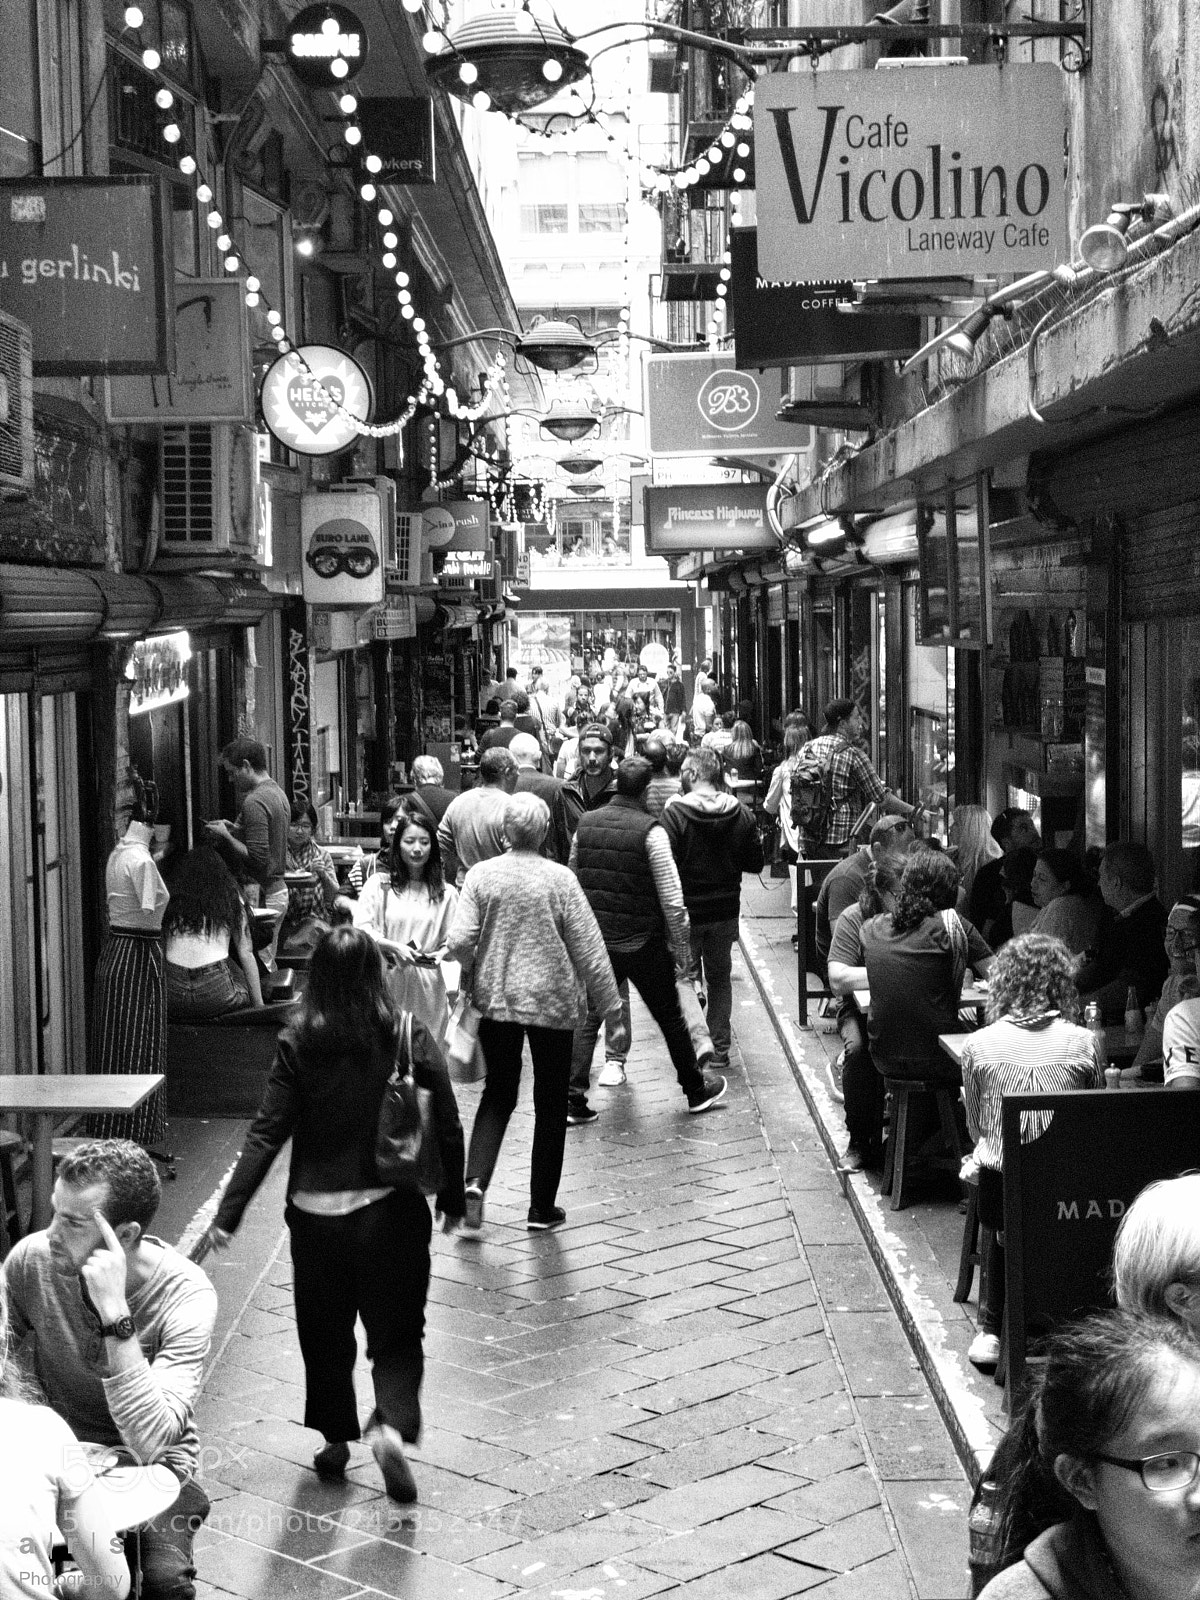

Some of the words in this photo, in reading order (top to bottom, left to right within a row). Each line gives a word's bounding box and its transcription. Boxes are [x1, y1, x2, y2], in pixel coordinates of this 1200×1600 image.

[845, 114, 909, 149] Cafe
[361, 157, 423, 170] Hwkers
[766, 105, 1050, 225] Vicolino
[907, 227, 996, 254] Laneway
[1003, 222, 1050, 248] Cafe
[21, 243, 141, 291] gerlinki
[716, 505, 764, 527] Highway
[316, 533, 343, 543] EURO
[344, 533, 370, 543] LANE
[1057, 1199, 1126, 1220] MAD
